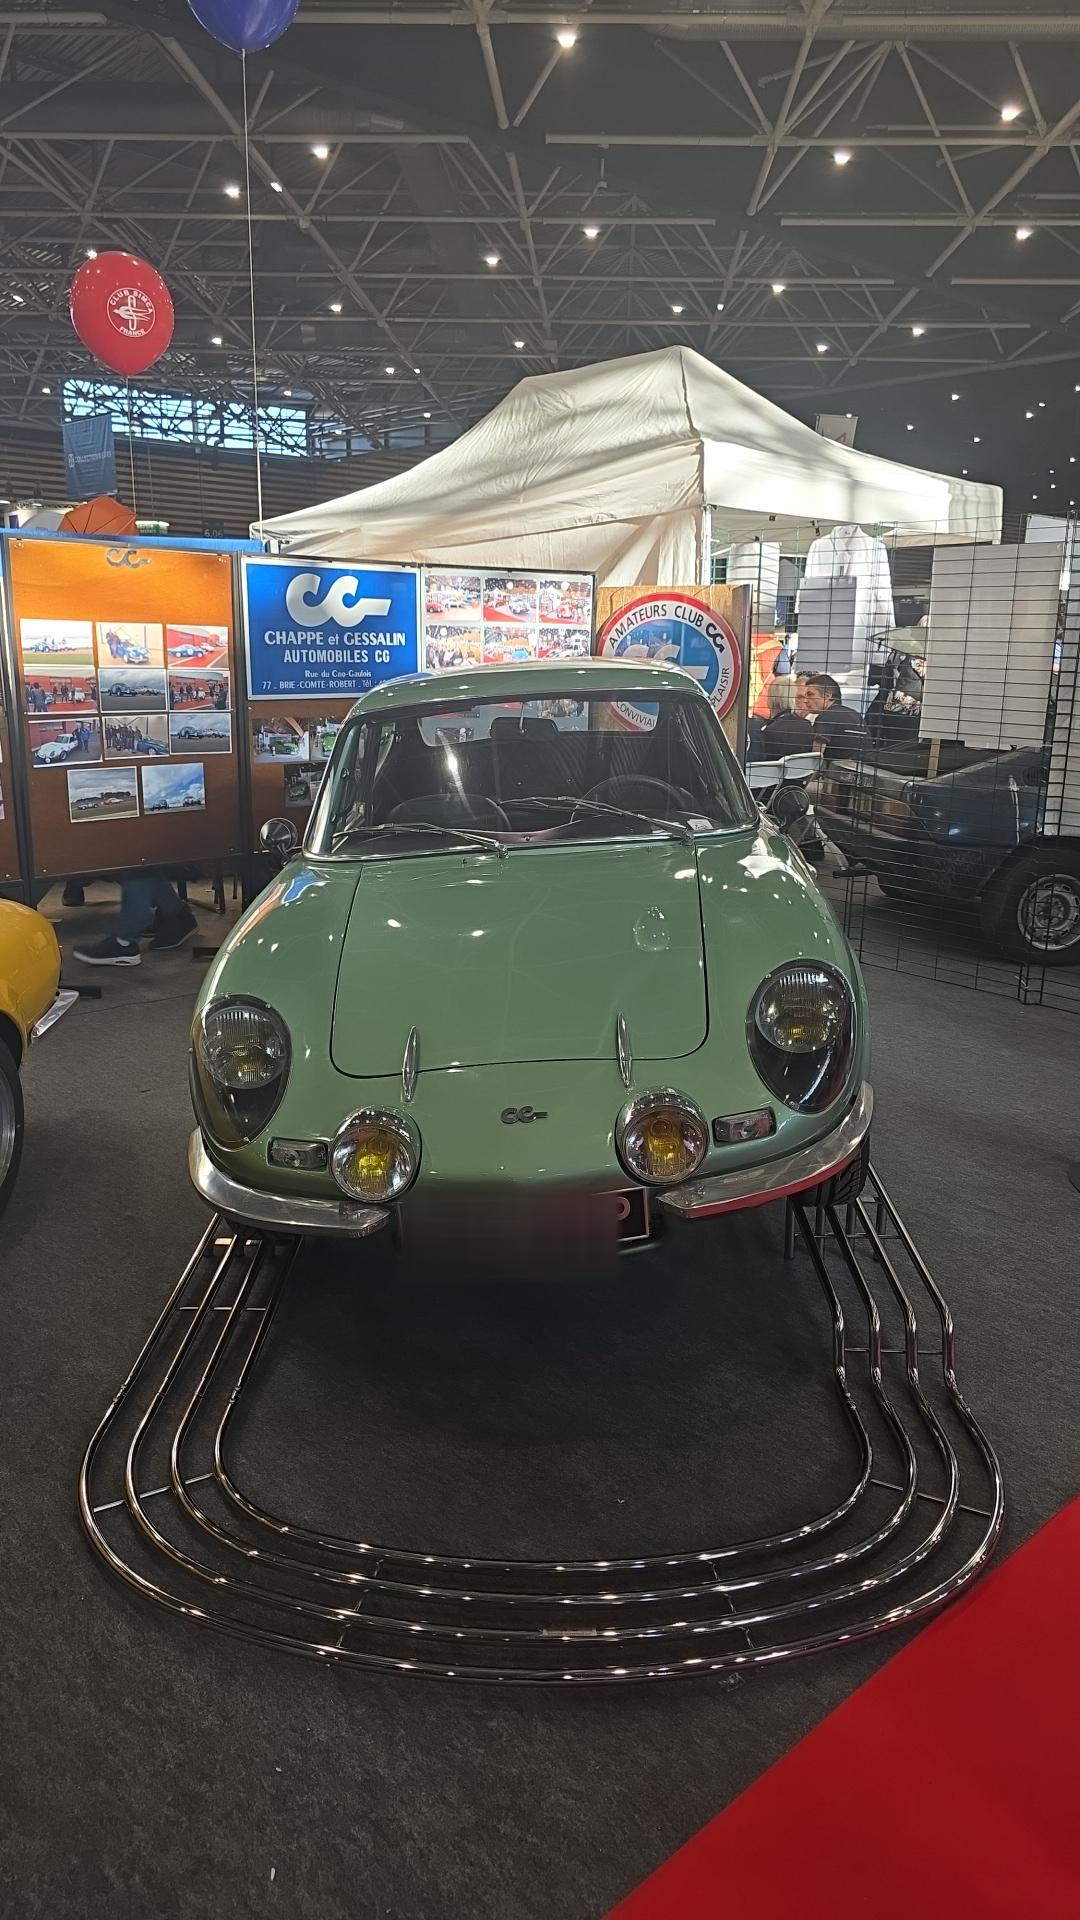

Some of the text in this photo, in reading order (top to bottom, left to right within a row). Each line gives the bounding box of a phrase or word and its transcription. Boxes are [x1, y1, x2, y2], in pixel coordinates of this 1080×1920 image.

[110, 290, 153, 314] CLUB SIMCA
[120, 326, 146, 337] FRANCE
[609, 604, 667, 650] AMATEURS
[674, 605, 704, 628] CLUB
[264, 630, 406, 646] CHAPPE et GESSALIN
[284, 650, 390, 663] AUTOMOBILES CG
[305, 670, 318, 678] Rue
[321, 670, 330, 678] du
[262, 682, 271, 690] 77
